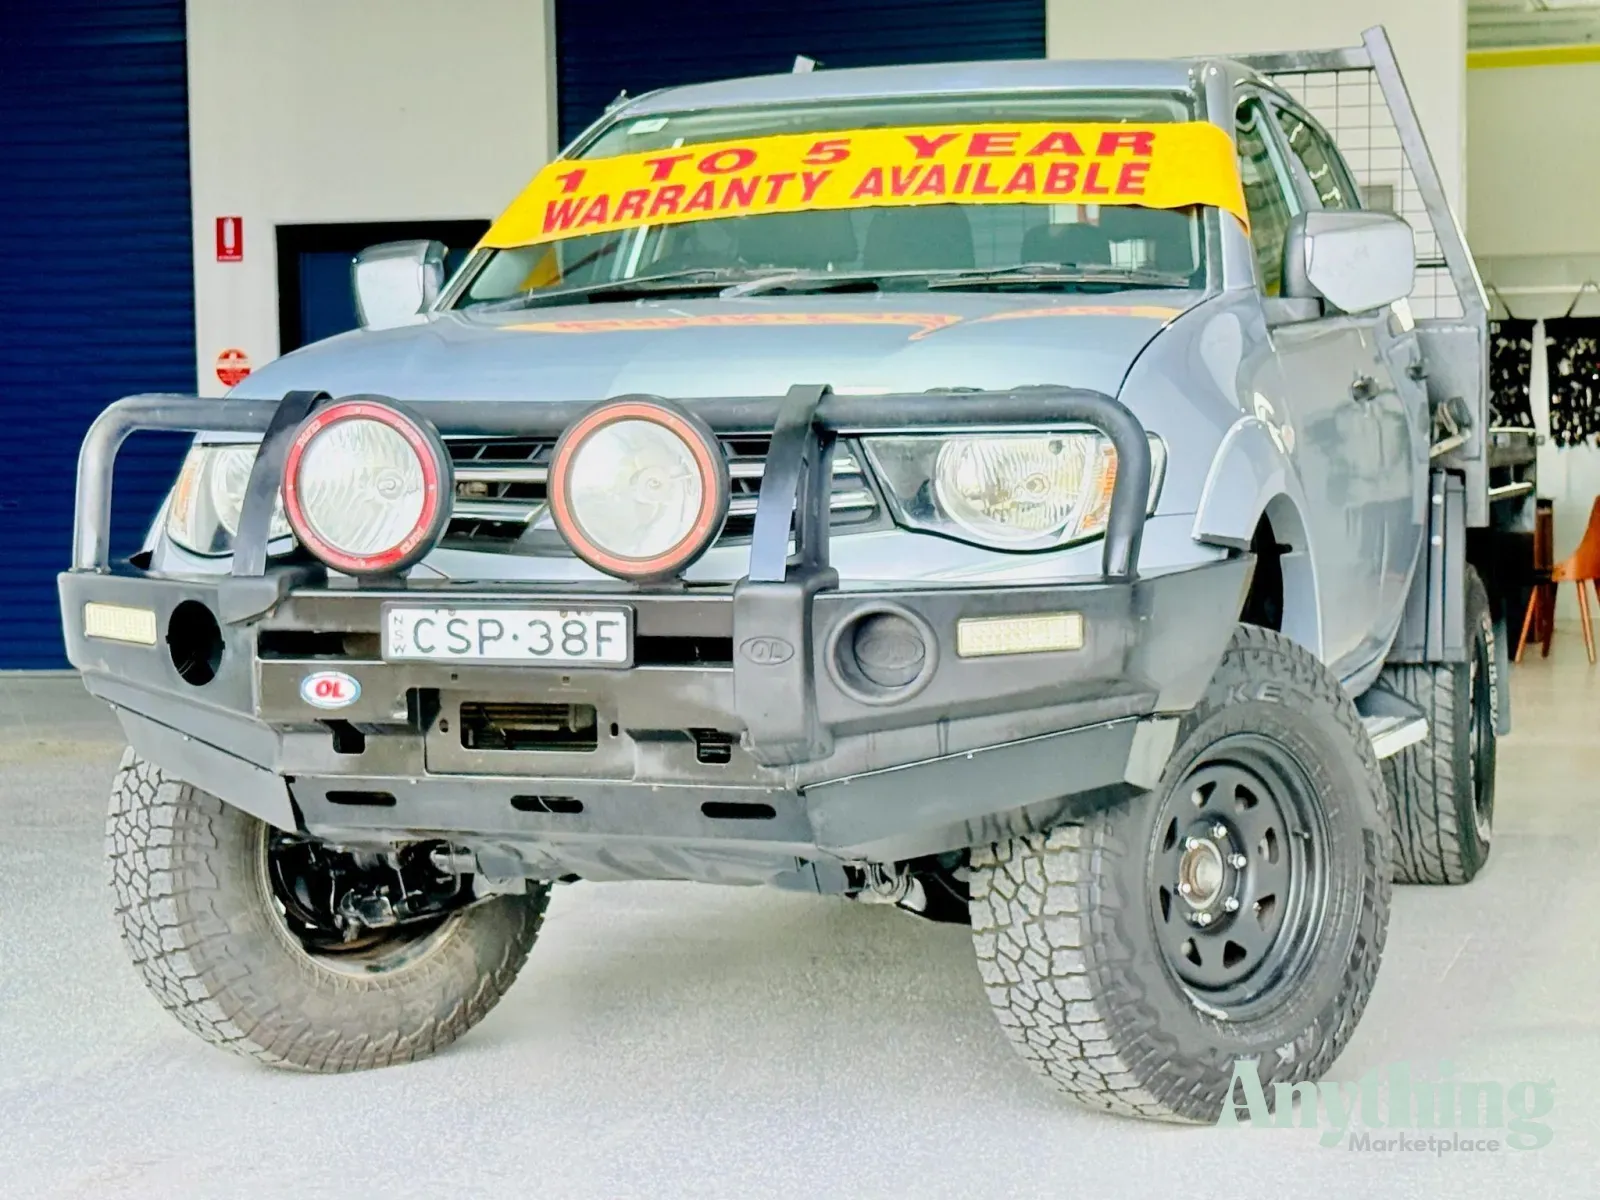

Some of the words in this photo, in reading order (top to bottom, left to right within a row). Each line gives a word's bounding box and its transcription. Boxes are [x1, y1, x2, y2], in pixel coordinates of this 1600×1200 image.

[556, 168, 587, 194] 1
[644, 148, 758, 183] TO
[801, 138, 852, 166] 5
[904, 131, 1156, 160] YEAR
[542, 169, 832, 234] WARRANTY
[850, 162, 1151, 199] AVAILABLE
[315, 680, 345, 698] OL
